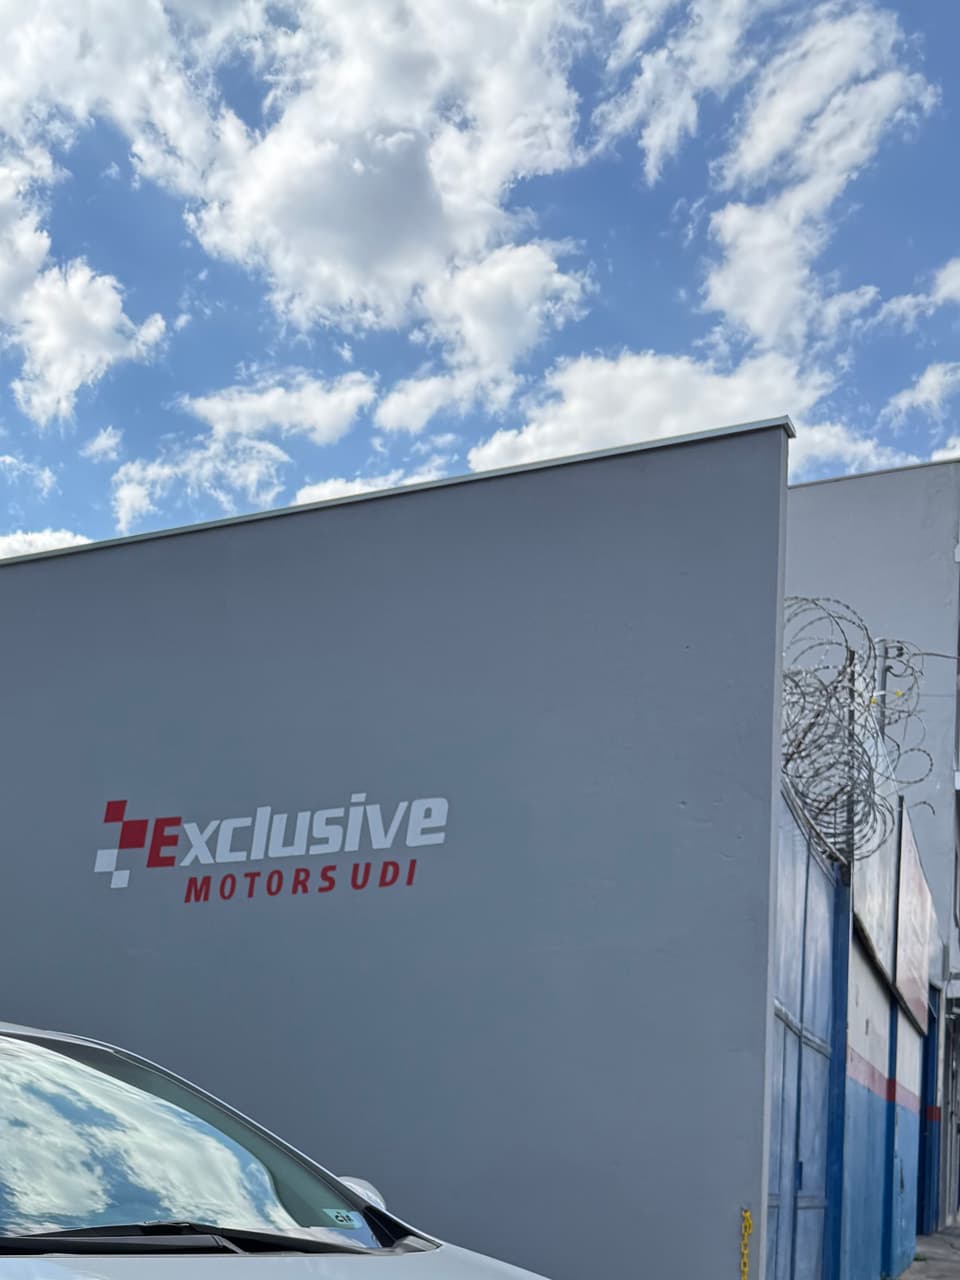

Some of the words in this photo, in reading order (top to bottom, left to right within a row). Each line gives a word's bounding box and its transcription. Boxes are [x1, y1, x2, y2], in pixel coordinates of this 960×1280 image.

[145, 792, 449, 869] Exclusive
[184, 864, 337, 904] MOTORS
[350, 858, 417, 891] UDI
